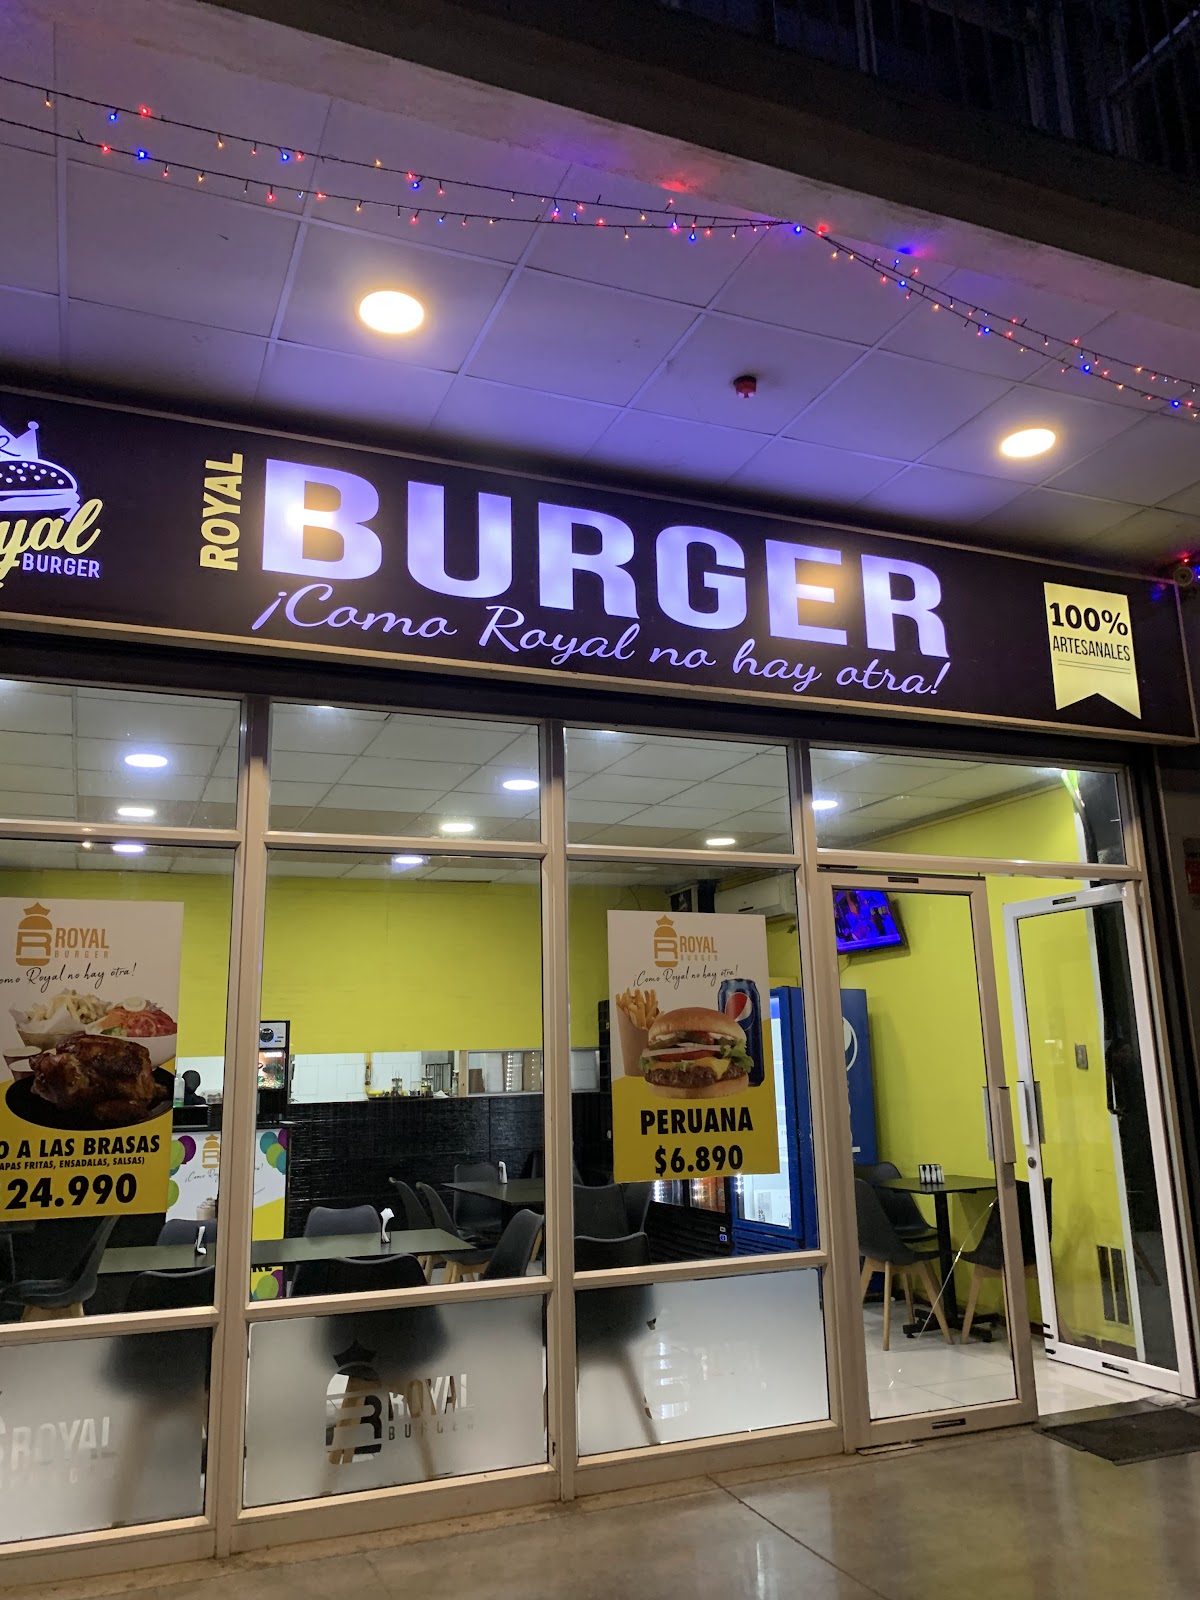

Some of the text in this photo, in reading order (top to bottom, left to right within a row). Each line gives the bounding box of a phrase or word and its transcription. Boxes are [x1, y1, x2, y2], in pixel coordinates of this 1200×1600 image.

[199, 452, 244, 572] ROYAL
[22, 552, 101, 579] BURGER
[261, 458, 950, 658] BURGER
[1049, 602, 1129, 636] 100%
[478, 605, 641, 665] Royal
[649, 646, 717, 668] no
[732, 638, 823, 692] hay
[836, 658, 951, 695] otra!
[1052, 635, 1131, 662] ARTESANALES
[54, 927, 110, 949] ROYAL
[679, 935, 718, 953] ROYAL
[54, 950, 109, 959] BURGER
[26, 964, 66, 993] Royal
[67, 972, 80, 980] no
[83, 962, 105, 990] hay
[110, 962, 137, 978] otra!
[662, 965, 691, 990] Royal
[702, 964, 717, 987] hay
[640, 1107, 754, 1136] PERUANA
[16, 1140, 31, 1159] A
[39, 1138, 75, 1158] LAS
[83, 1135, 160, 1156] BRASAS
[654, 1145, 744, 1177] $6.890
[24, 1160, 57, 1170] FRITAS,
[112, 1156, 145, 1167] SALSAS)
[5, 1172, 138, 1210] 24.990
